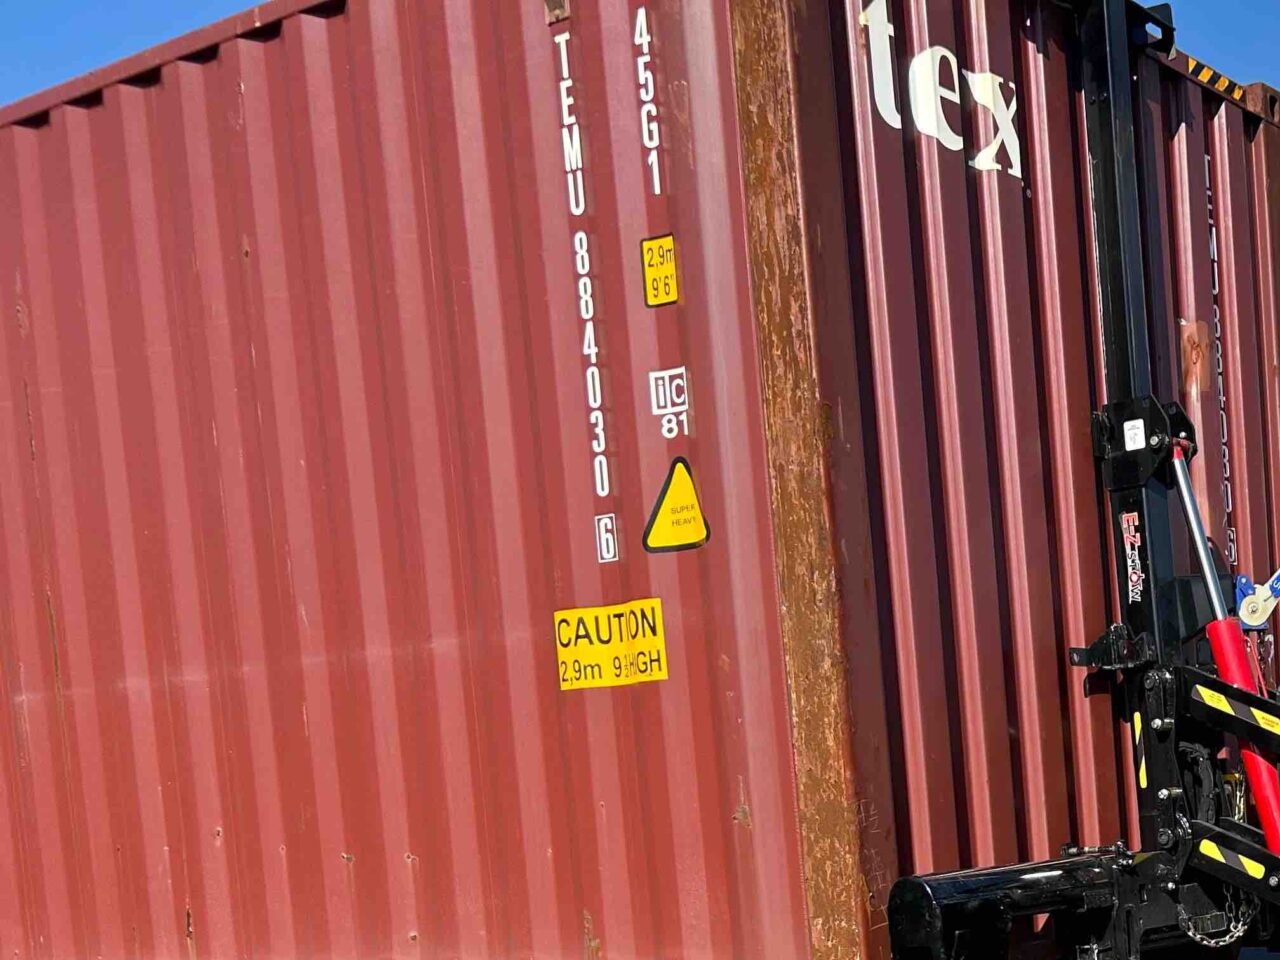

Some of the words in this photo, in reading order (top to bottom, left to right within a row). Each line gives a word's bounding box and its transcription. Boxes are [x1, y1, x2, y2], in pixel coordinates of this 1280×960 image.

[634, 6, 661, 195] 45G1
[554, 31, 586, 216] TEMU
[574, 231, 610, 497] 884030
[599, 517, 615, 560] 6
[661, 412, 689, 438] 81
[557, 606, 657, 648] CAUTION
[560, 659, 602, 686] 2,9m
